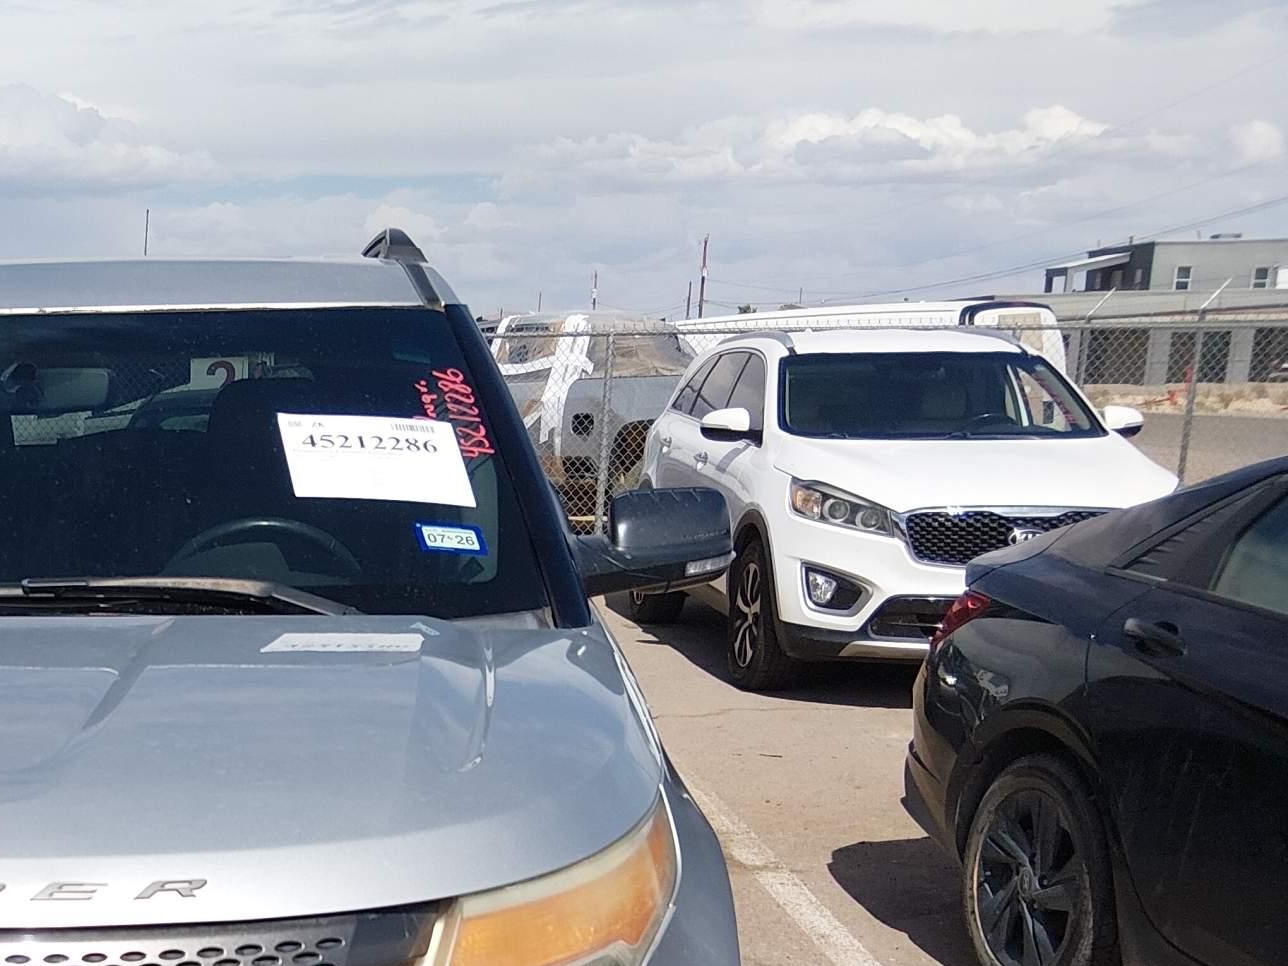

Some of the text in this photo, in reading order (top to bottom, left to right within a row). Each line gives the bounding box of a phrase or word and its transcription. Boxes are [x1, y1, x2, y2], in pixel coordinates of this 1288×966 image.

[432, 368, 495, 457] 45212286
[302, 433, 438, 454] 45212286
[427, 533, 475, 546] 07 26
